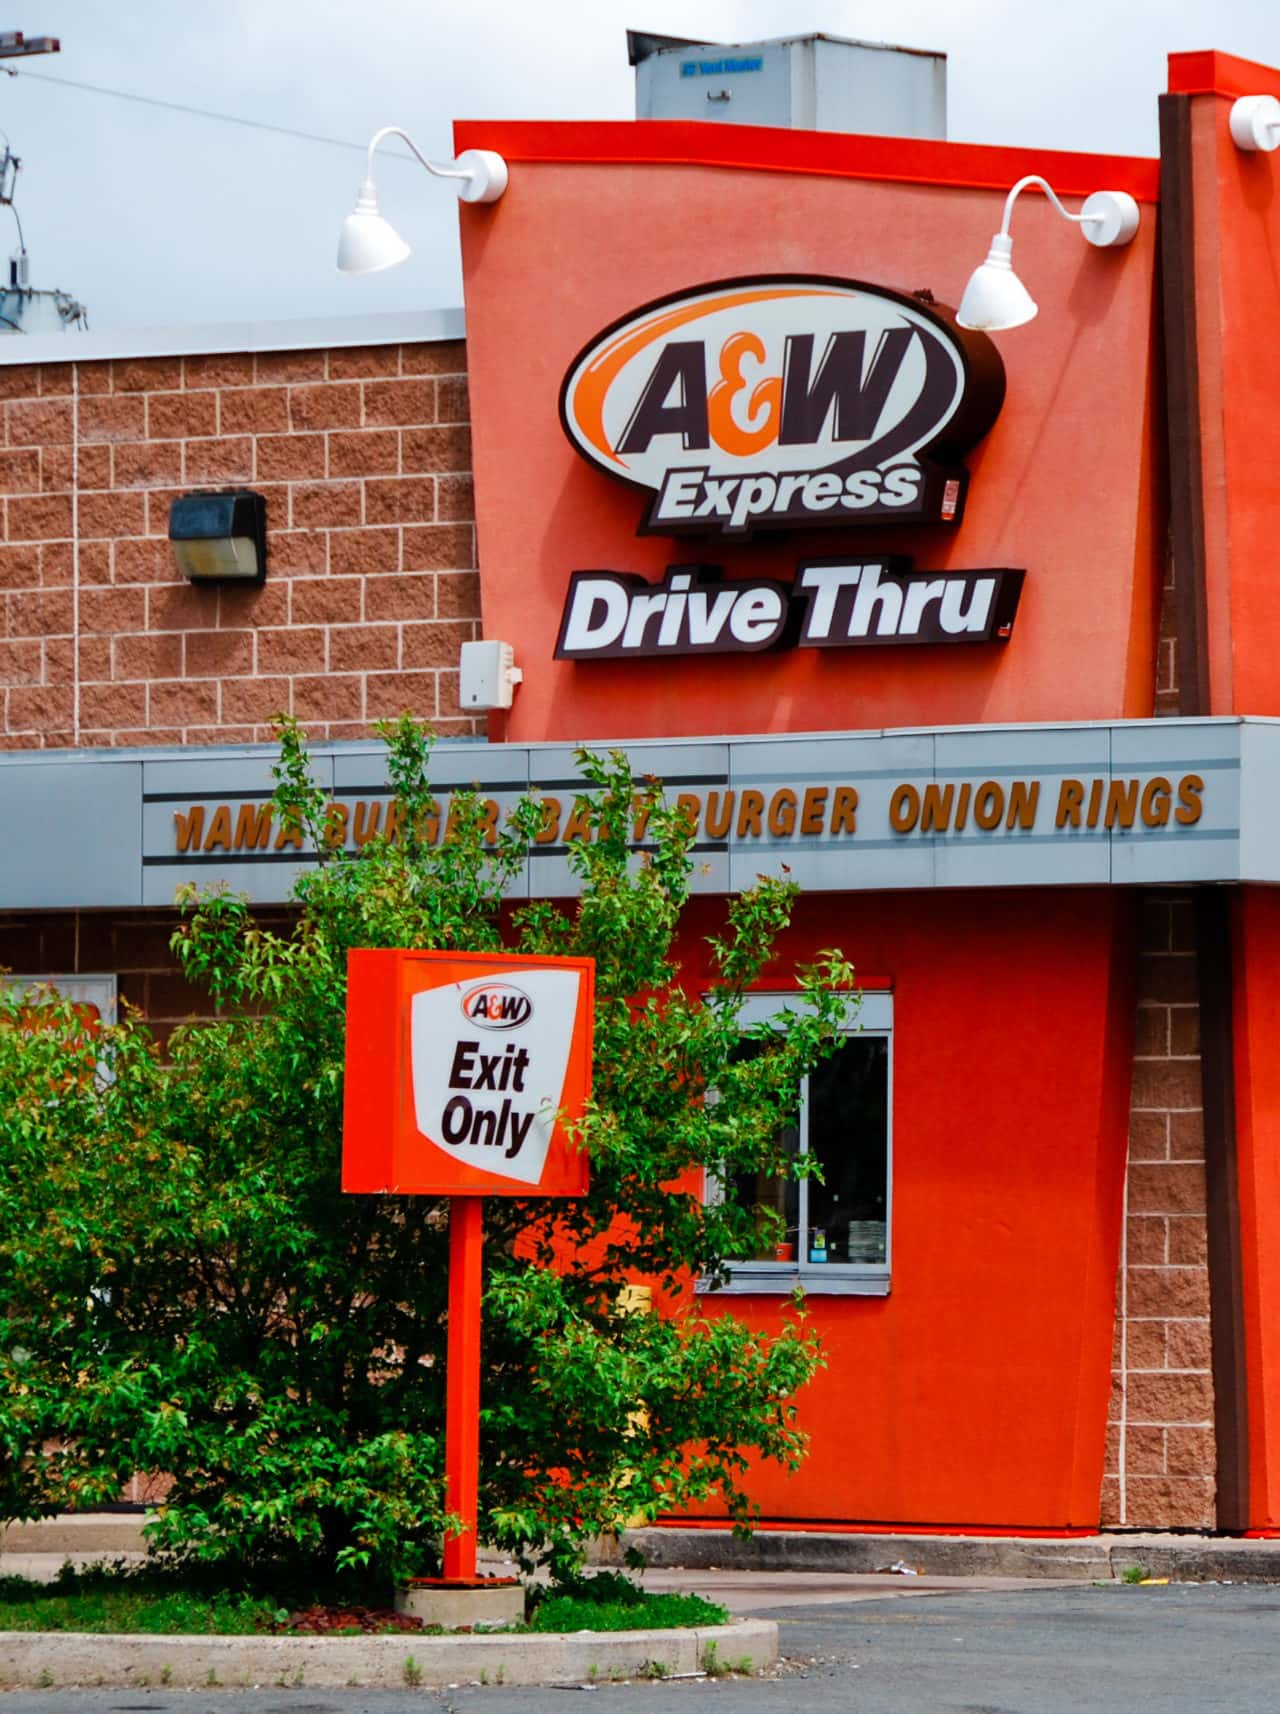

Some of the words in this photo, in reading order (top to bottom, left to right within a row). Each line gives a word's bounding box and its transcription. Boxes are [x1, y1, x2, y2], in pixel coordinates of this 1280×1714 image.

[614, 326, 918, 456] A&W
[657, 466, 921, 526] Express
[563, 575, 783, 651] Drive
[800, 565, 996, 640] Thru
[889, 780, 1040, 833] ONION
[1055, 774, 1204, 829] RINGS
[472, 994, 525, 1021] A&W
[448, 1040, 530, 1092] Exit
[441, 1095, 536, 1159] Only
